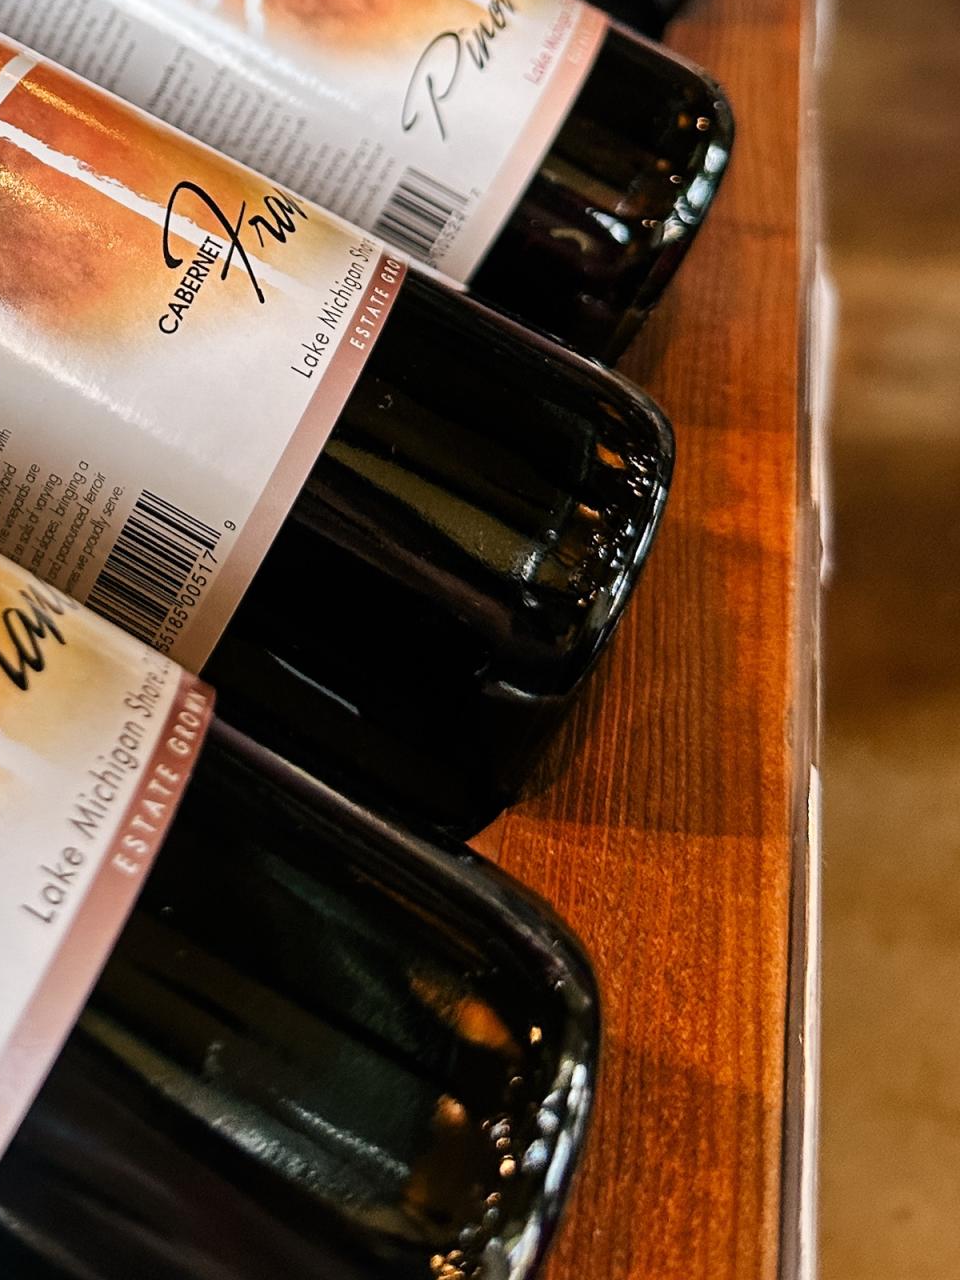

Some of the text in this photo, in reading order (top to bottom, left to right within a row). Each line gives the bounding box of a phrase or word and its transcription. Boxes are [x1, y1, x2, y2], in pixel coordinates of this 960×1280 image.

[158, 235, 224, 335] CABERNET
[290, 331, 330, 379] Lake
[317, 260, 364, 330] Michigan
[349, 258, 401, 351] ESTATE GRO
[6, 483, 31, 528] vineyards
[25, 464, 40, 484] are
[26, 508, 39, 524] of
[34, 473, 63, 511] varying
[49, 472, 87, 517] bringing
[78, 460, 89, 471] a
[56, 501, 90, 564] pronounced
[83, 472, 106, 505] terroir
[82, 516, 111, 558] proudly
[102, 486, 123, 517] serve.
[18, 523, 35, 544] soils
[181, 549, 219, 608] 00517
[224, 519, 237, 531] 9
[21, 846, 84, 925] Lake
[67, 722, 145, 839] Michigan
[124, 671, 165, 719] Shore
[113, 764, 181, 876] ESTATE
